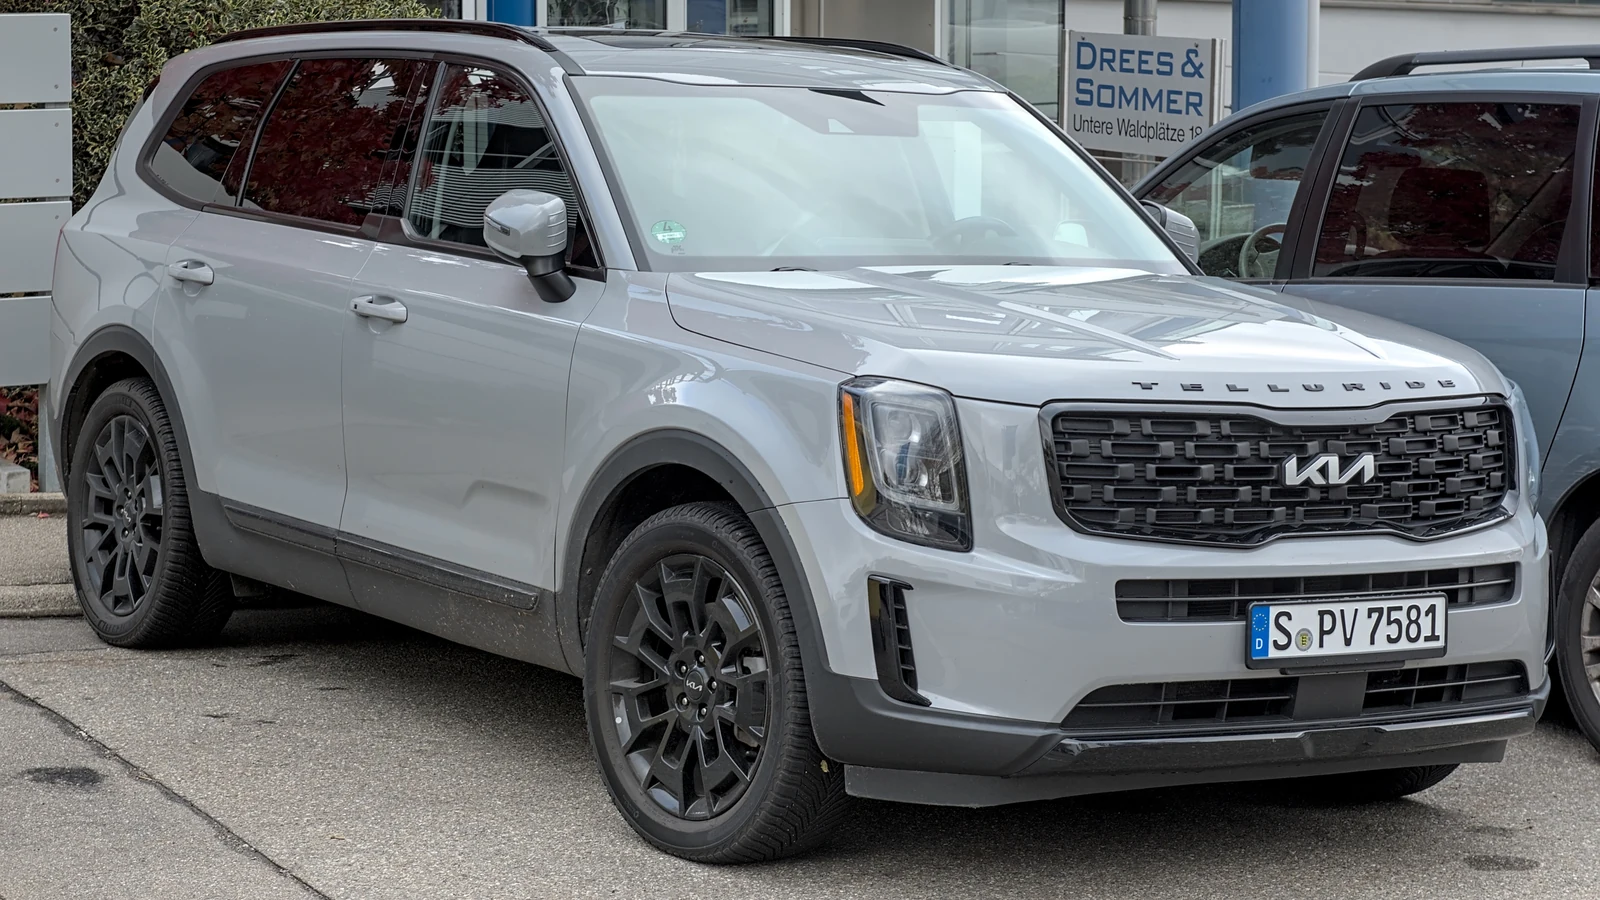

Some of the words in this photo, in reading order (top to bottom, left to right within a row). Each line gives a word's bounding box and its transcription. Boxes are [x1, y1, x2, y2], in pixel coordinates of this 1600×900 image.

[1076, 41, 1174, 77] DREES
[1181, 48, 1205, 79] &
[1075, 77, 1204, 117] SOMMER
[1073, 113, 1113, 136] Untere
[1116, 117, 1185, 143] Waldplätze
[1131, 378, 1456, 393] TELLURIDE
[1283, 451, 1375, 487] KIA
[1255, 638, 1264, 650] D
[1272, 610, 1293, 651] S
[1317, 608, 1359, 648] PV
[1367, 603, 1441, 646] 7581
